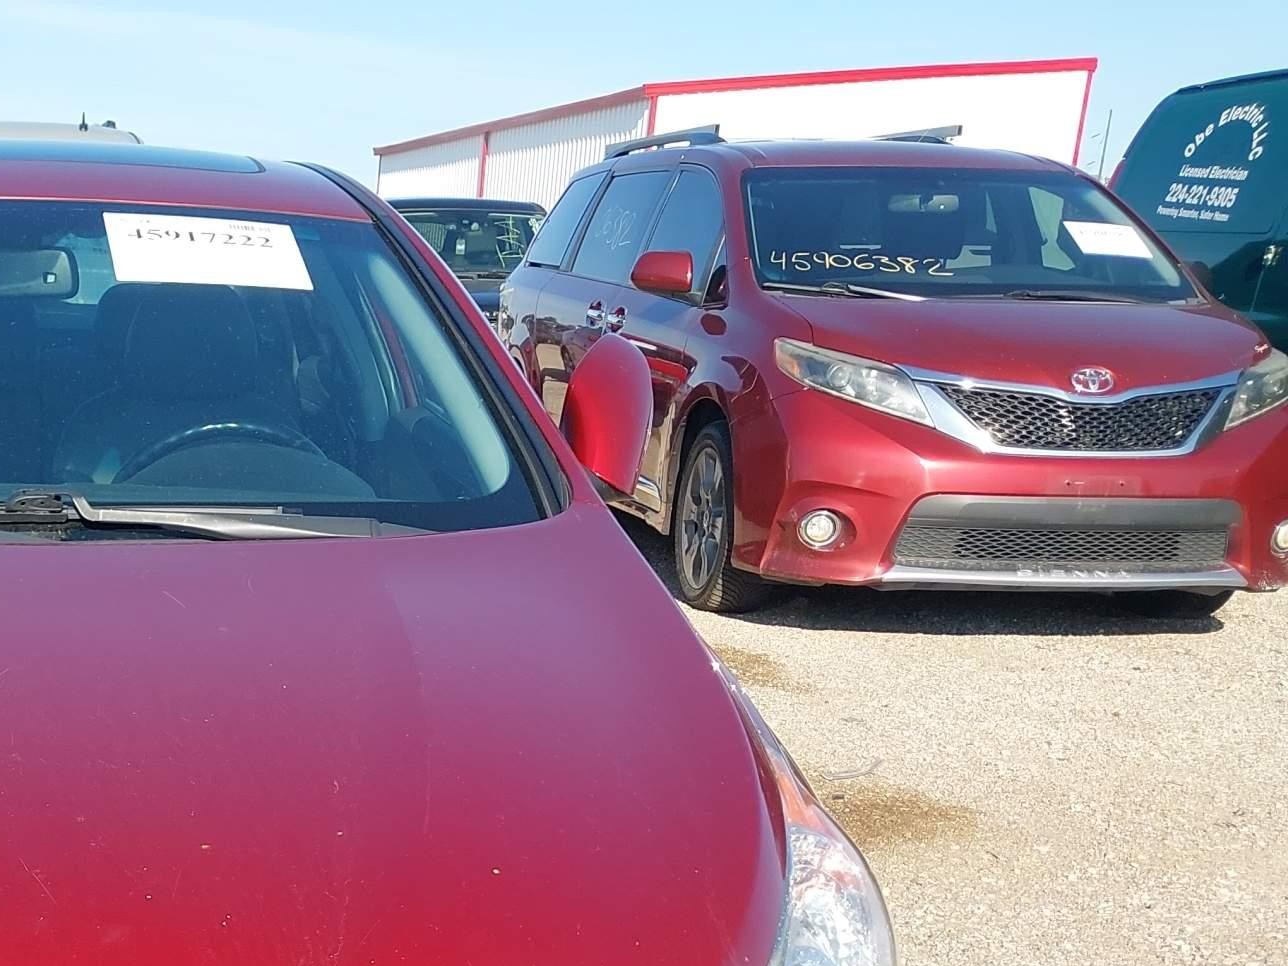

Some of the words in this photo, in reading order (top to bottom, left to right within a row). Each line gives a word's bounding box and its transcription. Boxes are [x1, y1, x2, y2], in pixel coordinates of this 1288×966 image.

[1218, 101, 1266, 128] Electric
[1248, 121, 1270, 161] LLC
[1179, 164, 1211, 178] Licensed
[1208, 166, 1248, 181] Electrician
[1165, 182, 1240, 208] 224-221-9305
[127, 227, 274, 249] 45917222
[770, 250, 954, 276] 45906382
